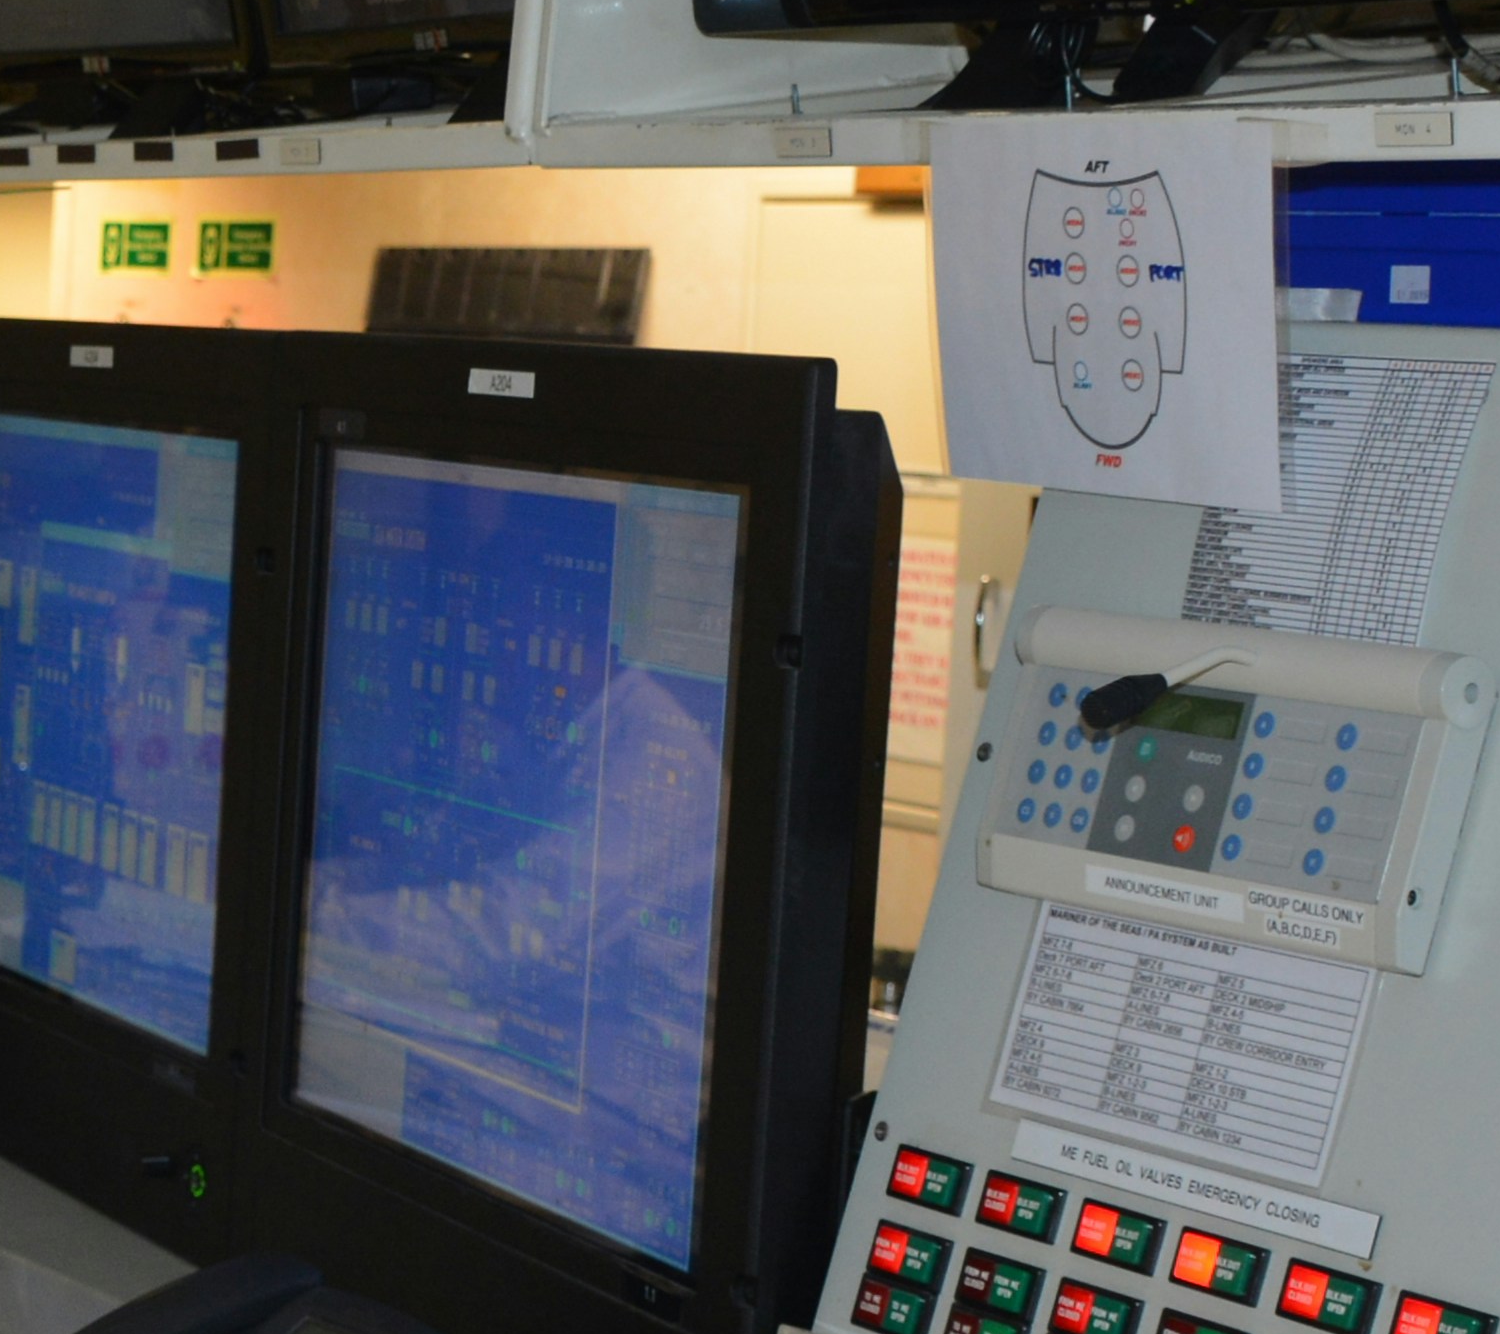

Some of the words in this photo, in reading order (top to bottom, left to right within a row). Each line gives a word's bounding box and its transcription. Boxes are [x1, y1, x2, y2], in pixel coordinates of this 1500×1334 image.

[1085, 161, 1109, 174] AFT
[1096, 454, 1122, 467] FWD
[1104, 876, 1192, 906] ANNOUNCEMENT
[1194, 895, 1219, 910] UNIT
[1248, 891, 1290, 911] GROUP
[1292, 899, 1330, 917] CALLS
[1331, 906, 1364, 924] ONLY
[1060, 1145, 1077, 1160] ME
[1082, 1151, 1109, 1169] FUEL
[1115, 1159, 1133, 1177] OIL
[1140, 1166, 1183, 1190] VALVES
[1188, 1179, 1260, 1211] EMERGENCY
[1266, 1201, 1320, 1229] CLOSING
